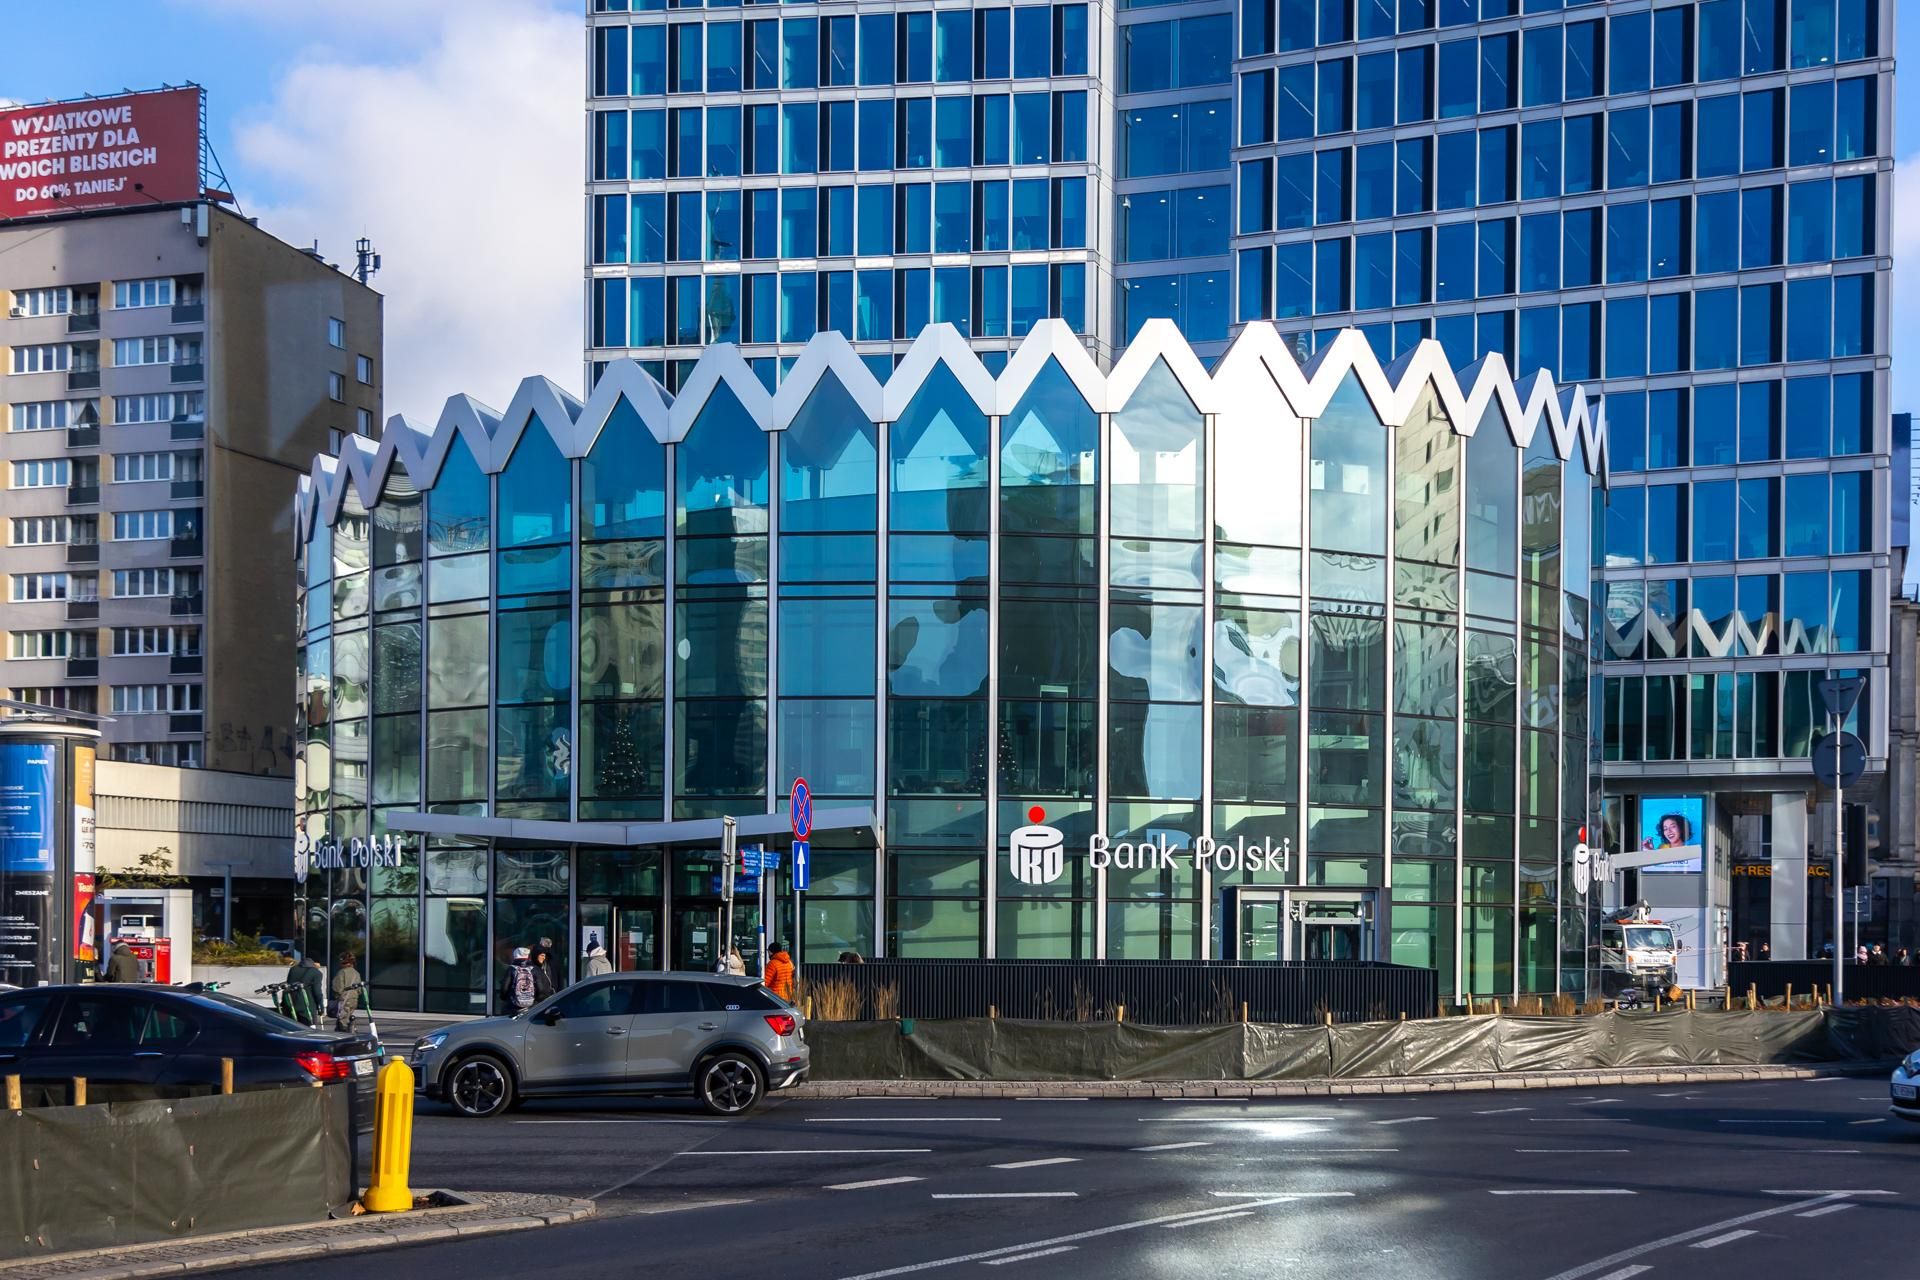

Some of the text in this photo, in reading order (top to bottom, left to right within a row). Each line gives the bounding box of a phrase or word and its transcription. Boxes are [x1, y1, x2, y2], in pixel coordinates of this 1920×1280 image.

[12, 106, 132, 135] WYJĄTKOWE
[4, 127, 140, 158] PREZENTY DLA
[70, 147, 157, 173] BLISKICH
[16, 186, 38, 201] DO
[314, 837, 345, 869] Bank
[351, 834, 401, 868] Polski
[1089, 833, 1179, 870] Bank
[1195, 835, 1291, 872] Polski
